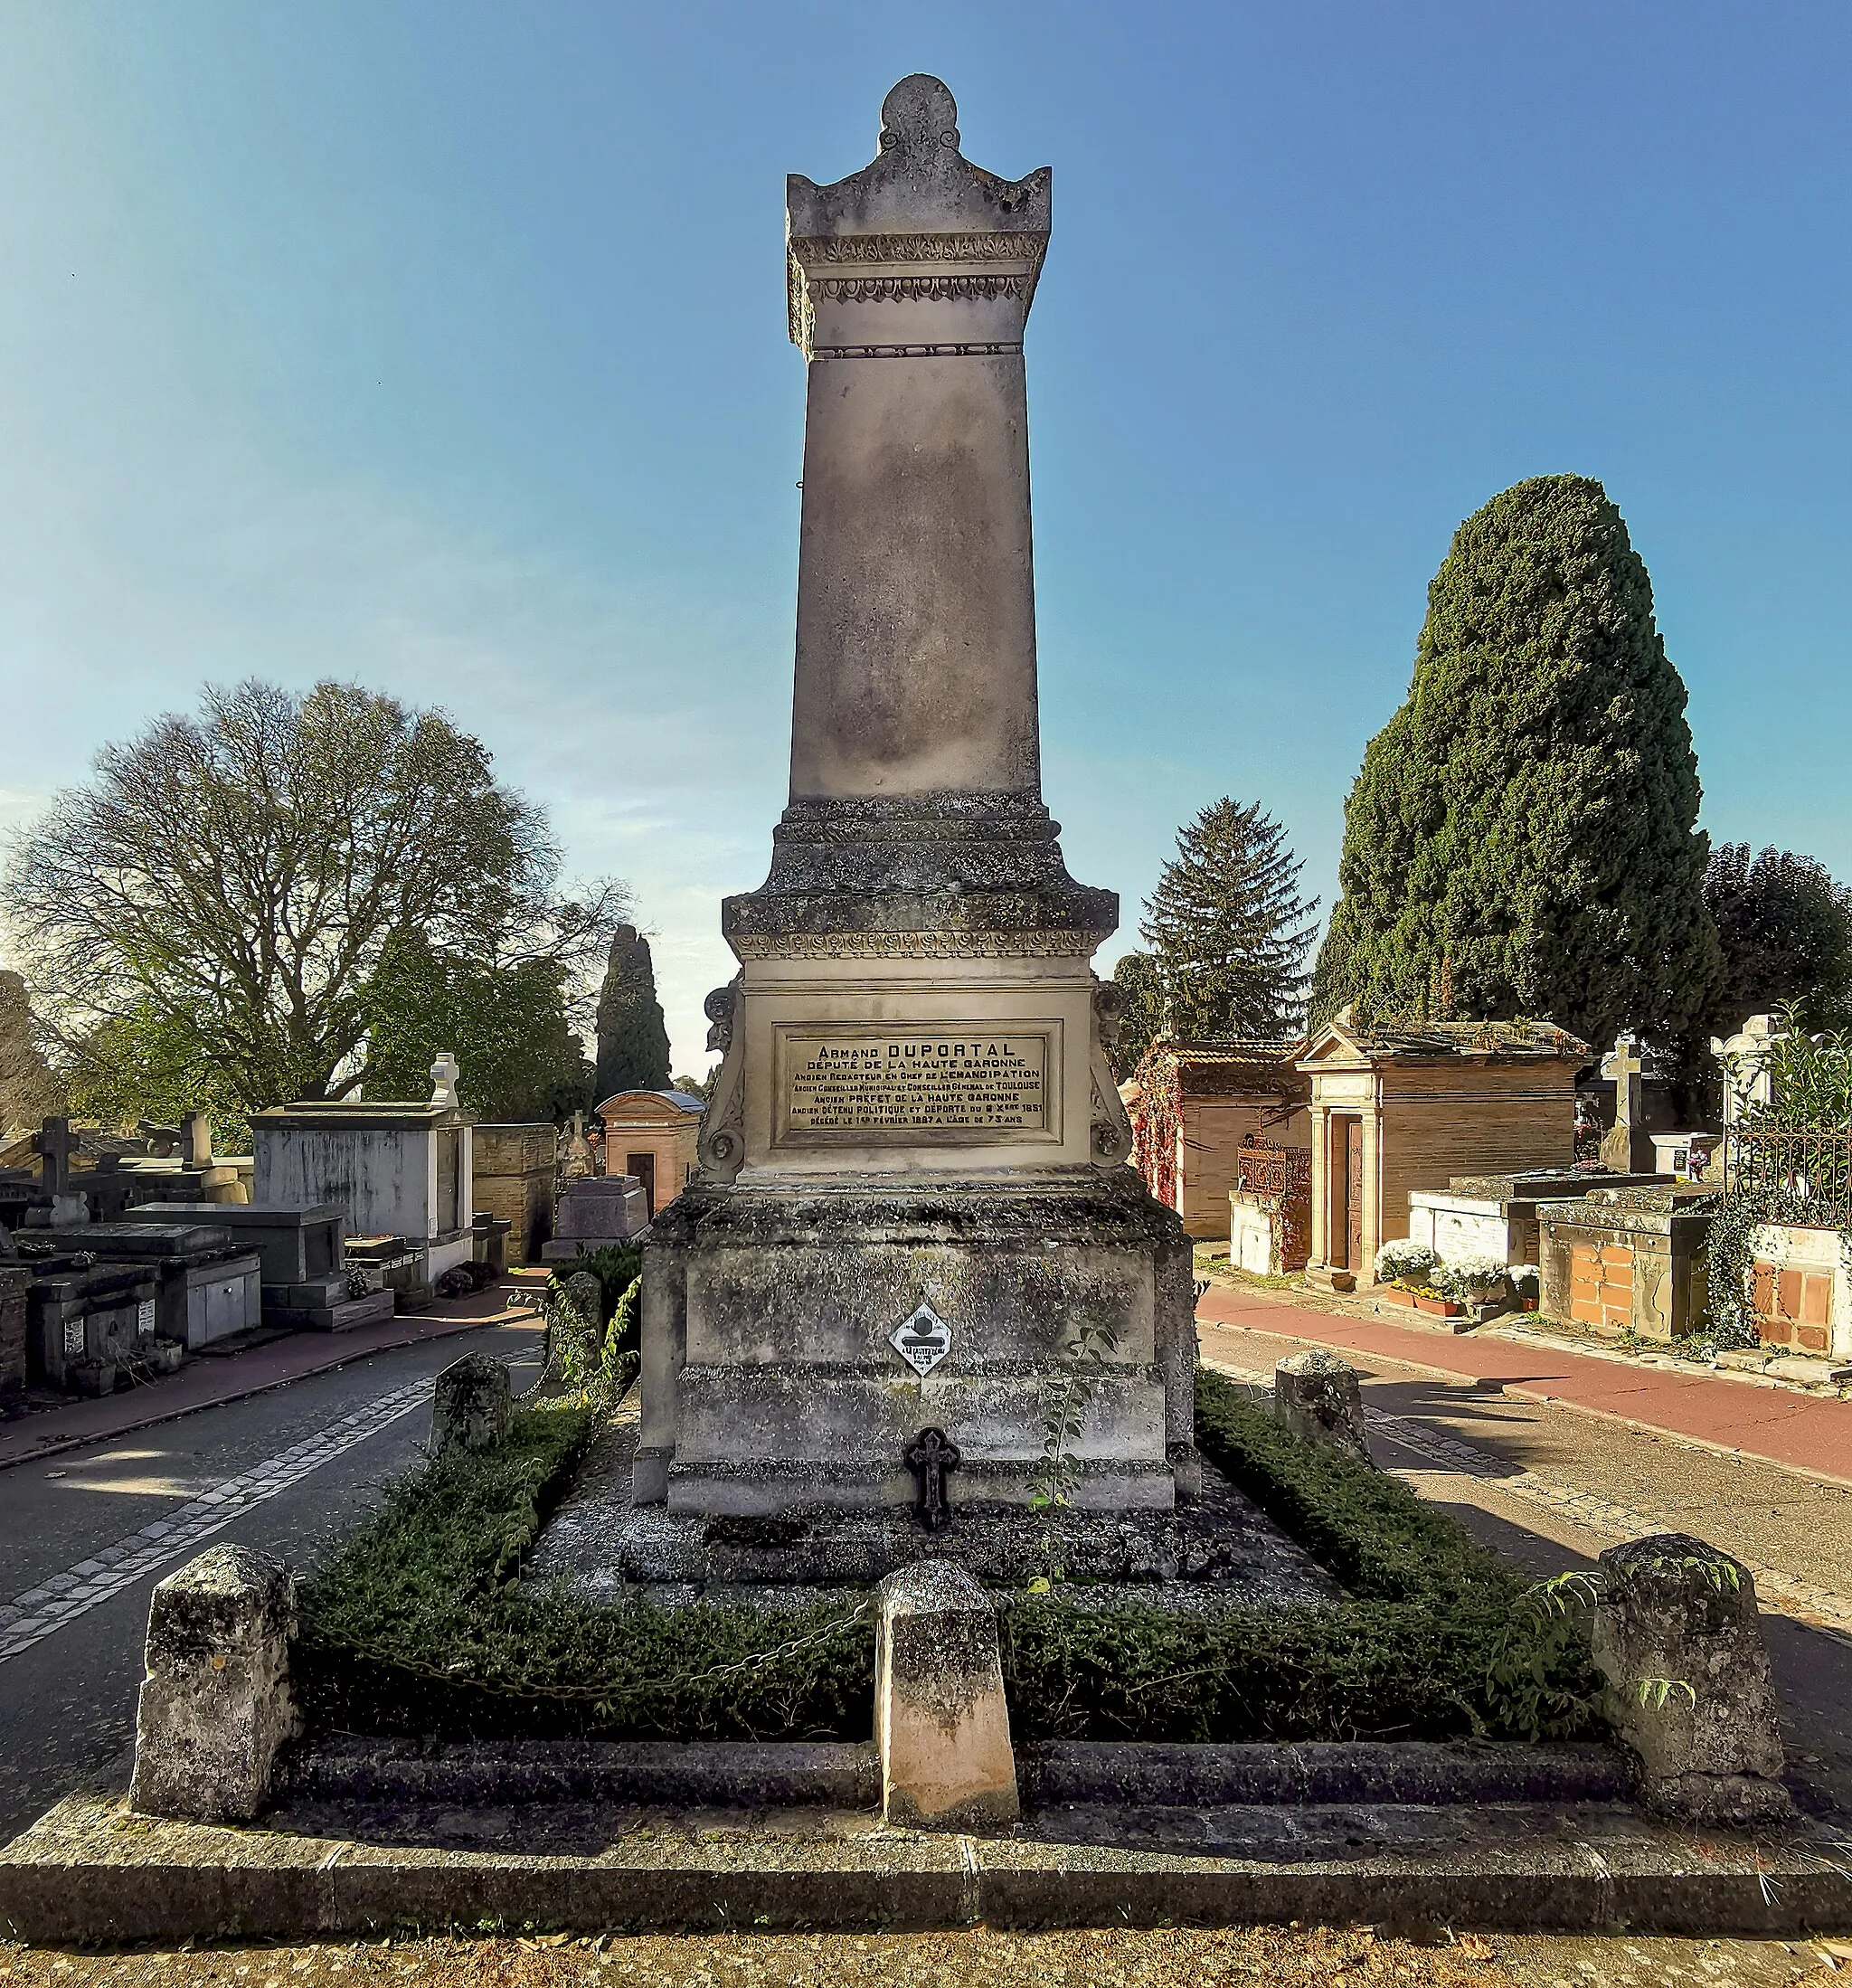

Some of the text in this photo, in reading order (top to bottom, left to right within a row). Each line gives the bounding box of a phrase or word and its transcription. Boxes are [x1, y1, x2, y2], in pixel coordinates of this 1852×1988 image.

[889, 1043, 1016, 1057] DUPORTAL
[808, 1058, 1025, 1070] DÉPUTÉ DE LA HAUTE GARONNE
[996, 1082, 1040, 1090] TOULOUSE
[895, 1094, 907, 1103] DE
[928, 1093, 963, 1102] HAUTE
[968, 1093, 1019, 1102] GARONNE
[822, 1104, 853, 1114] DÉTENU
[857, 1105, 904, 1114] POLITIQUE
[1022, 1104, 1042, 1112] 1851
